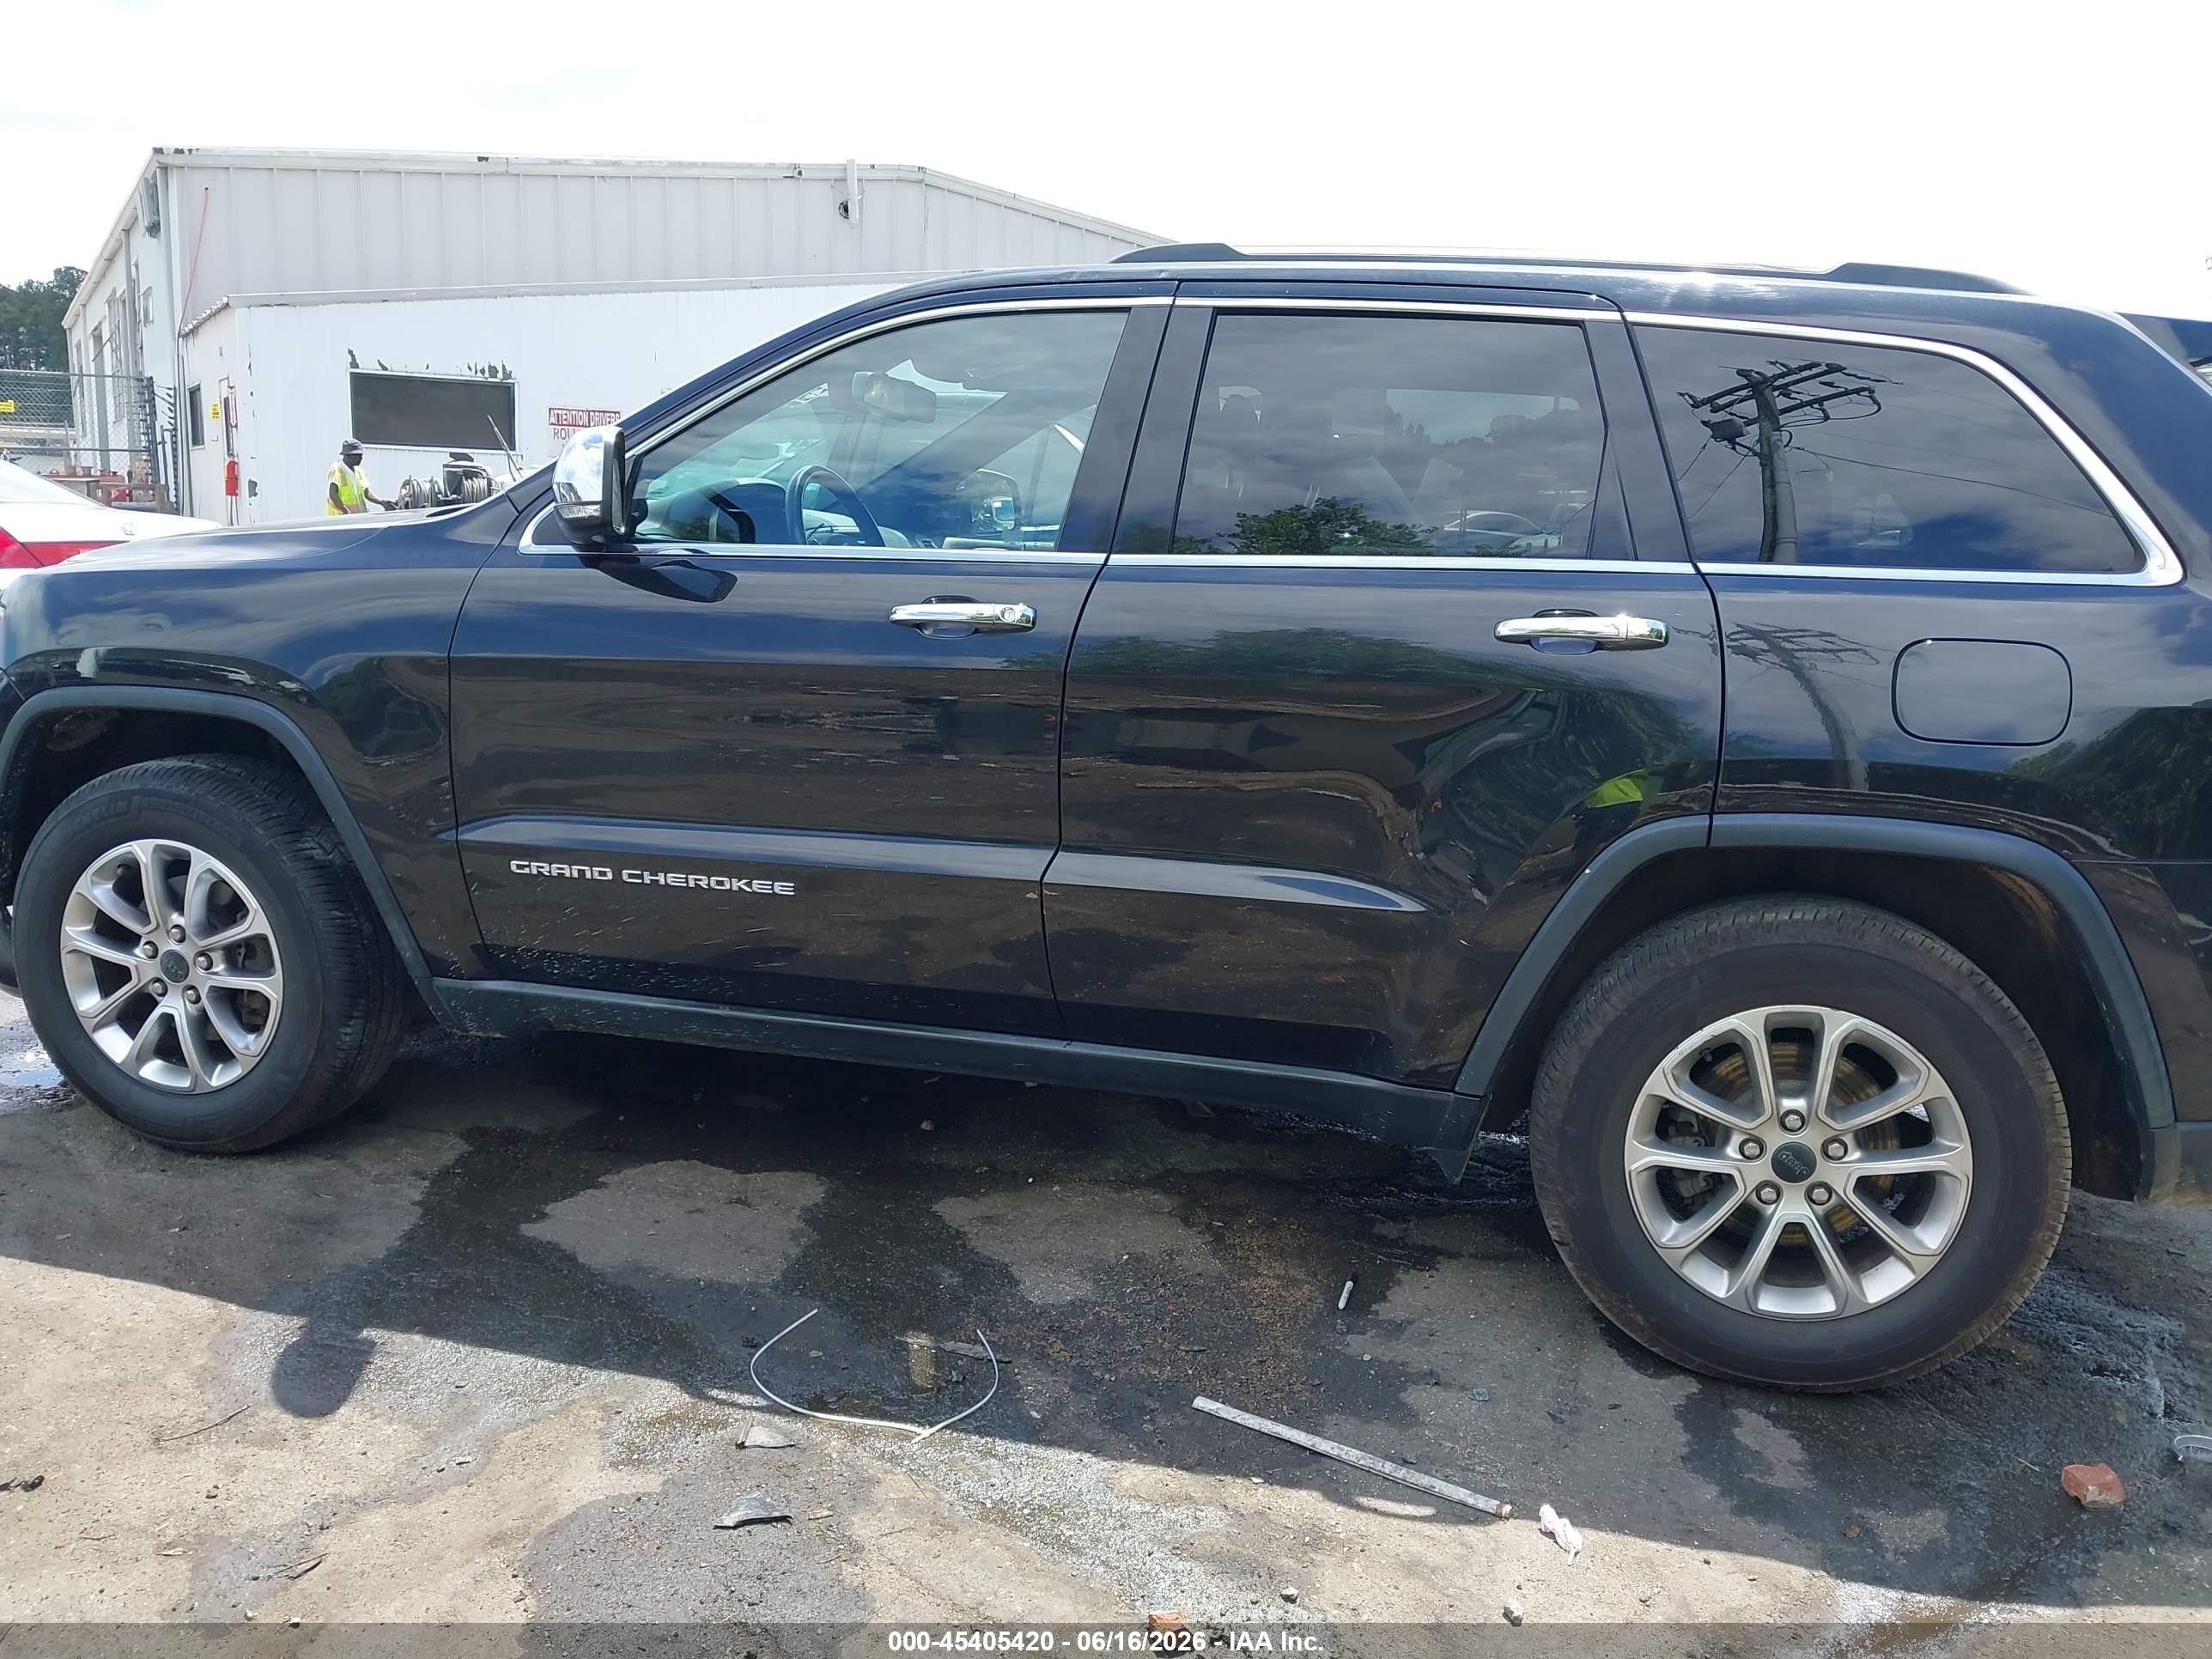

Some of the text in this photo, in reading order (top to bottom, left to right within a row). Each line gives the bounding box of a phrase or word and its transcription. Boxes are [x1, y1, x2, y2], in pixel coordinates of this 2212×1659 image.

[550, 410, 620, 427] ATTENTION DRIVERS
[509, 860, 796, 896] GRAND CHEROKEE
